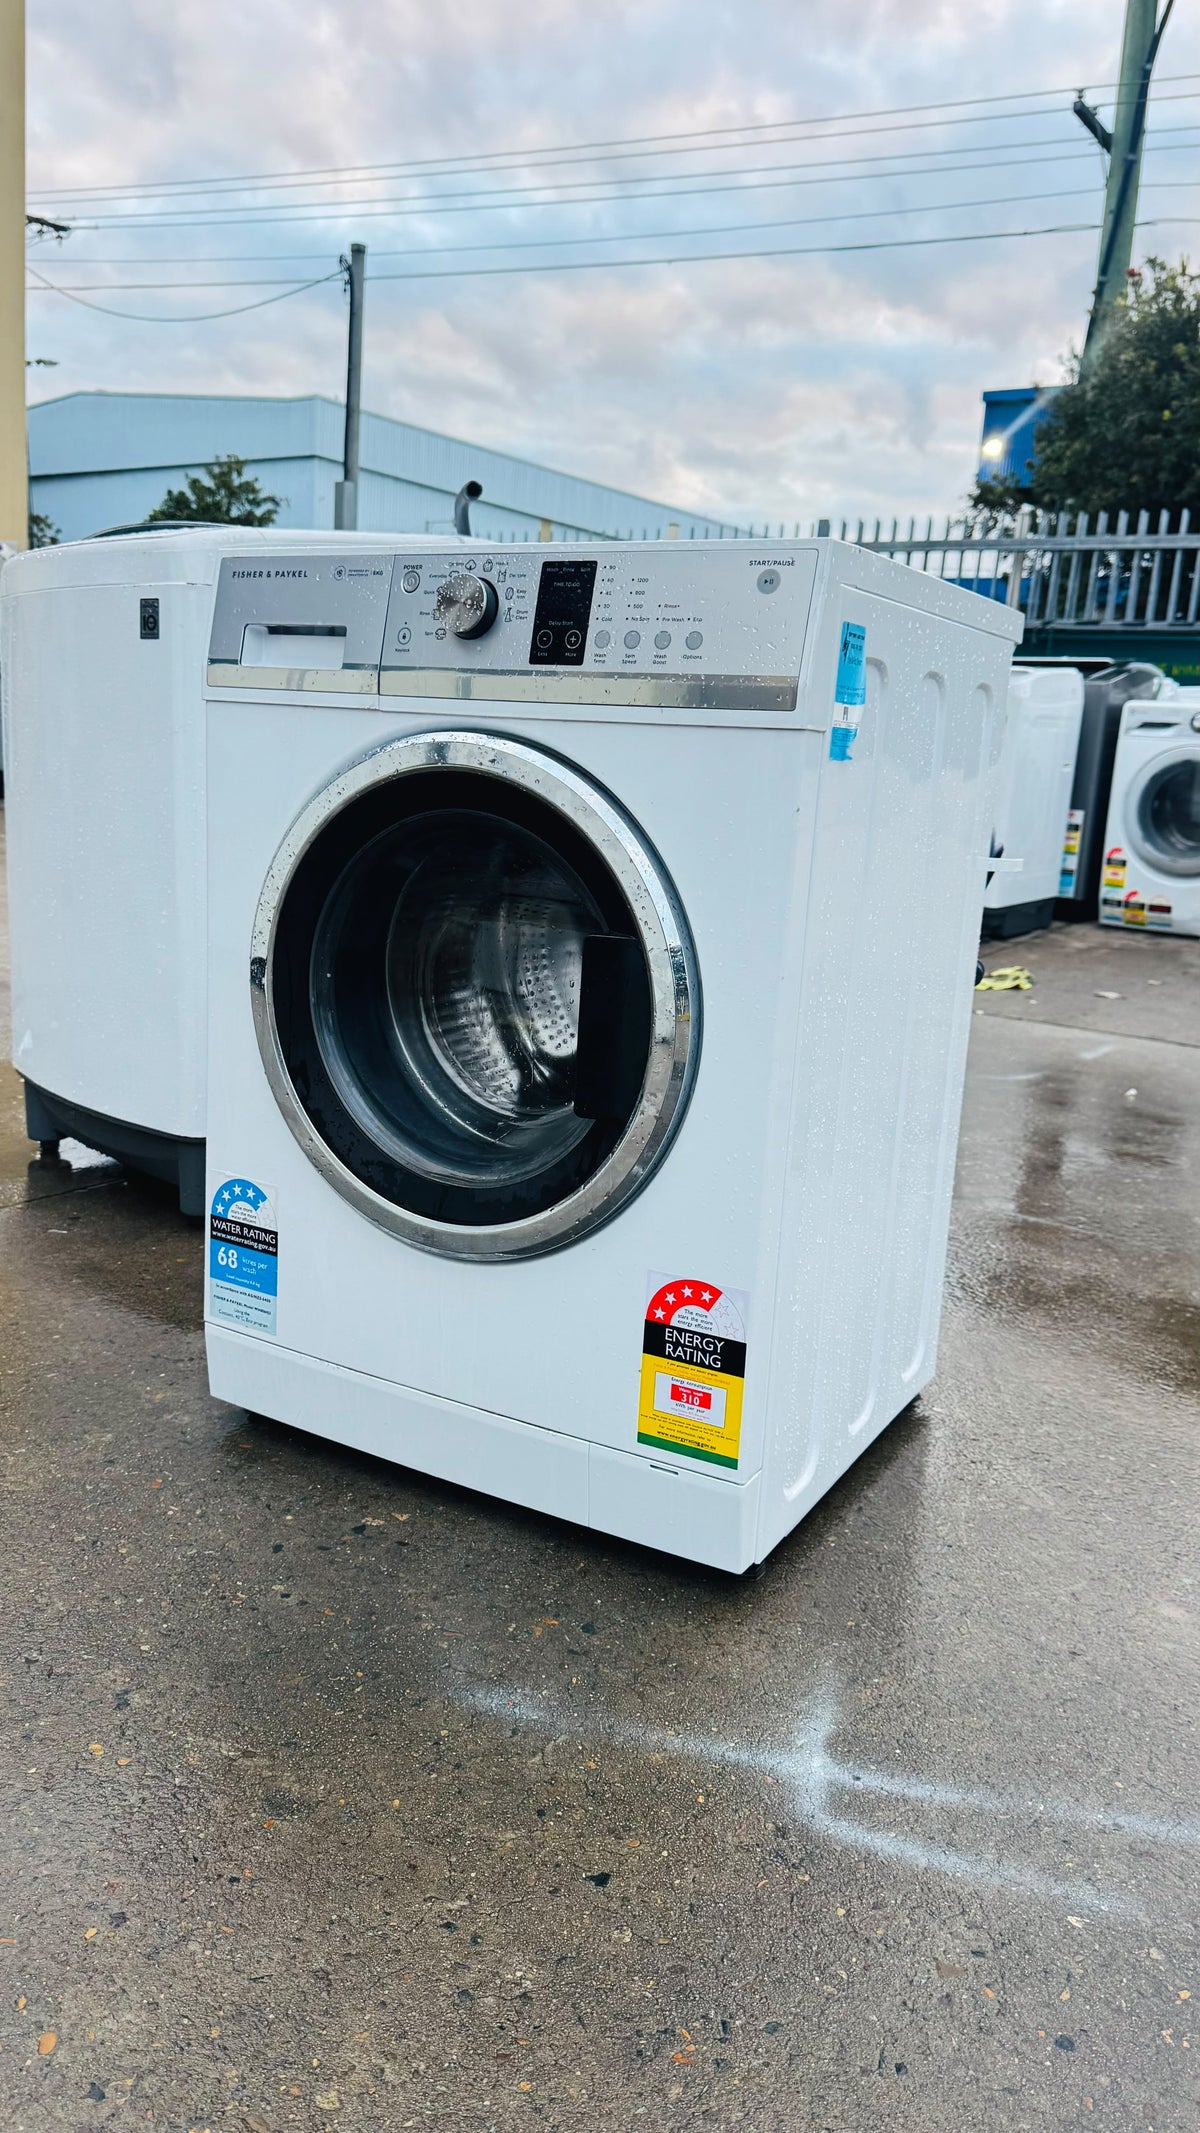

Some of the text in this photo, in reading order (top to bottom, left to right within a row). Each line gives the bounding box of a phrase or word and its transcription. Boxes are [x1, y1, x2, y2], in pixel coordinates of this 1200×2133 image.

[232, 570, 263, 579] FISHER
[274, 570, 308, 578] PAYKEL
[212, 1219, 276, 1244] WATER RATING
[212, 1231, 276, 1252] www.waterrating.gov.au
[218, 1246, 238, 1269] 68
[258, 1262, 268, 1270] per
[242, 1267, 257, 1275] wash
[677, 1320, 713, 1332] energy efficient
[665, 1328, 725, 1353] ENERGY
[665, 1343, 721, 1368] RATING
[681, 1393, 700, 1406] 310
